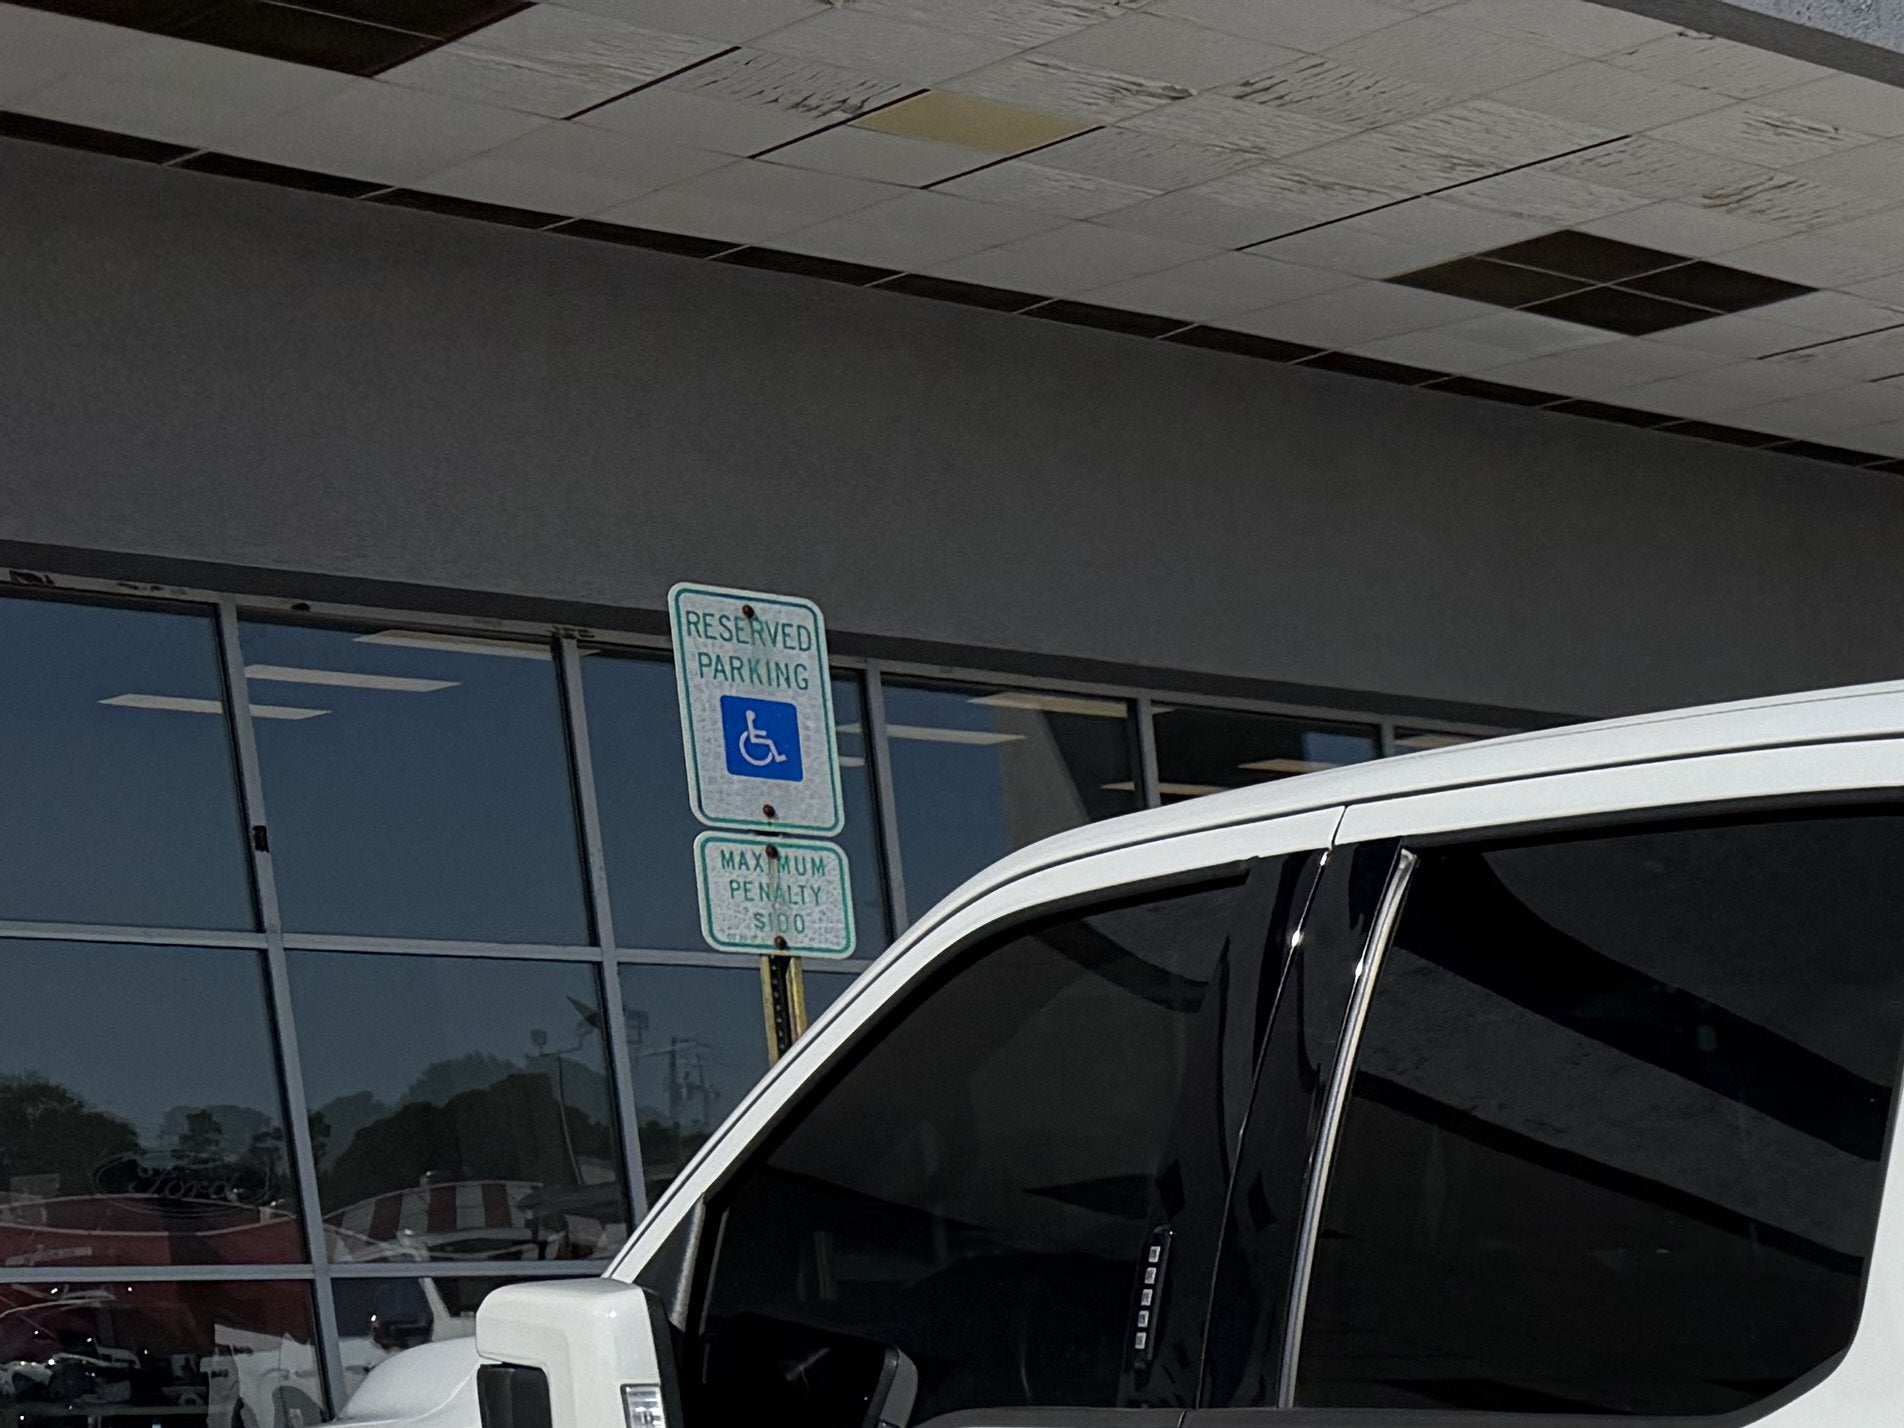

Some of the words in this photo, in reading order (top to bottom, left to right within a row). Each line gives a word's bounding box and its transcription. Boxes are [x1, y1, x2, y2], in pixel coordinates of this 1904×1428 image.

[685, 609, 813, 652] RESERVED
[697, 651, 810, 691] PARKING
[720, 849, 826, 877] MAXIMUM
[729, 879, 822, 906] PENALTY
